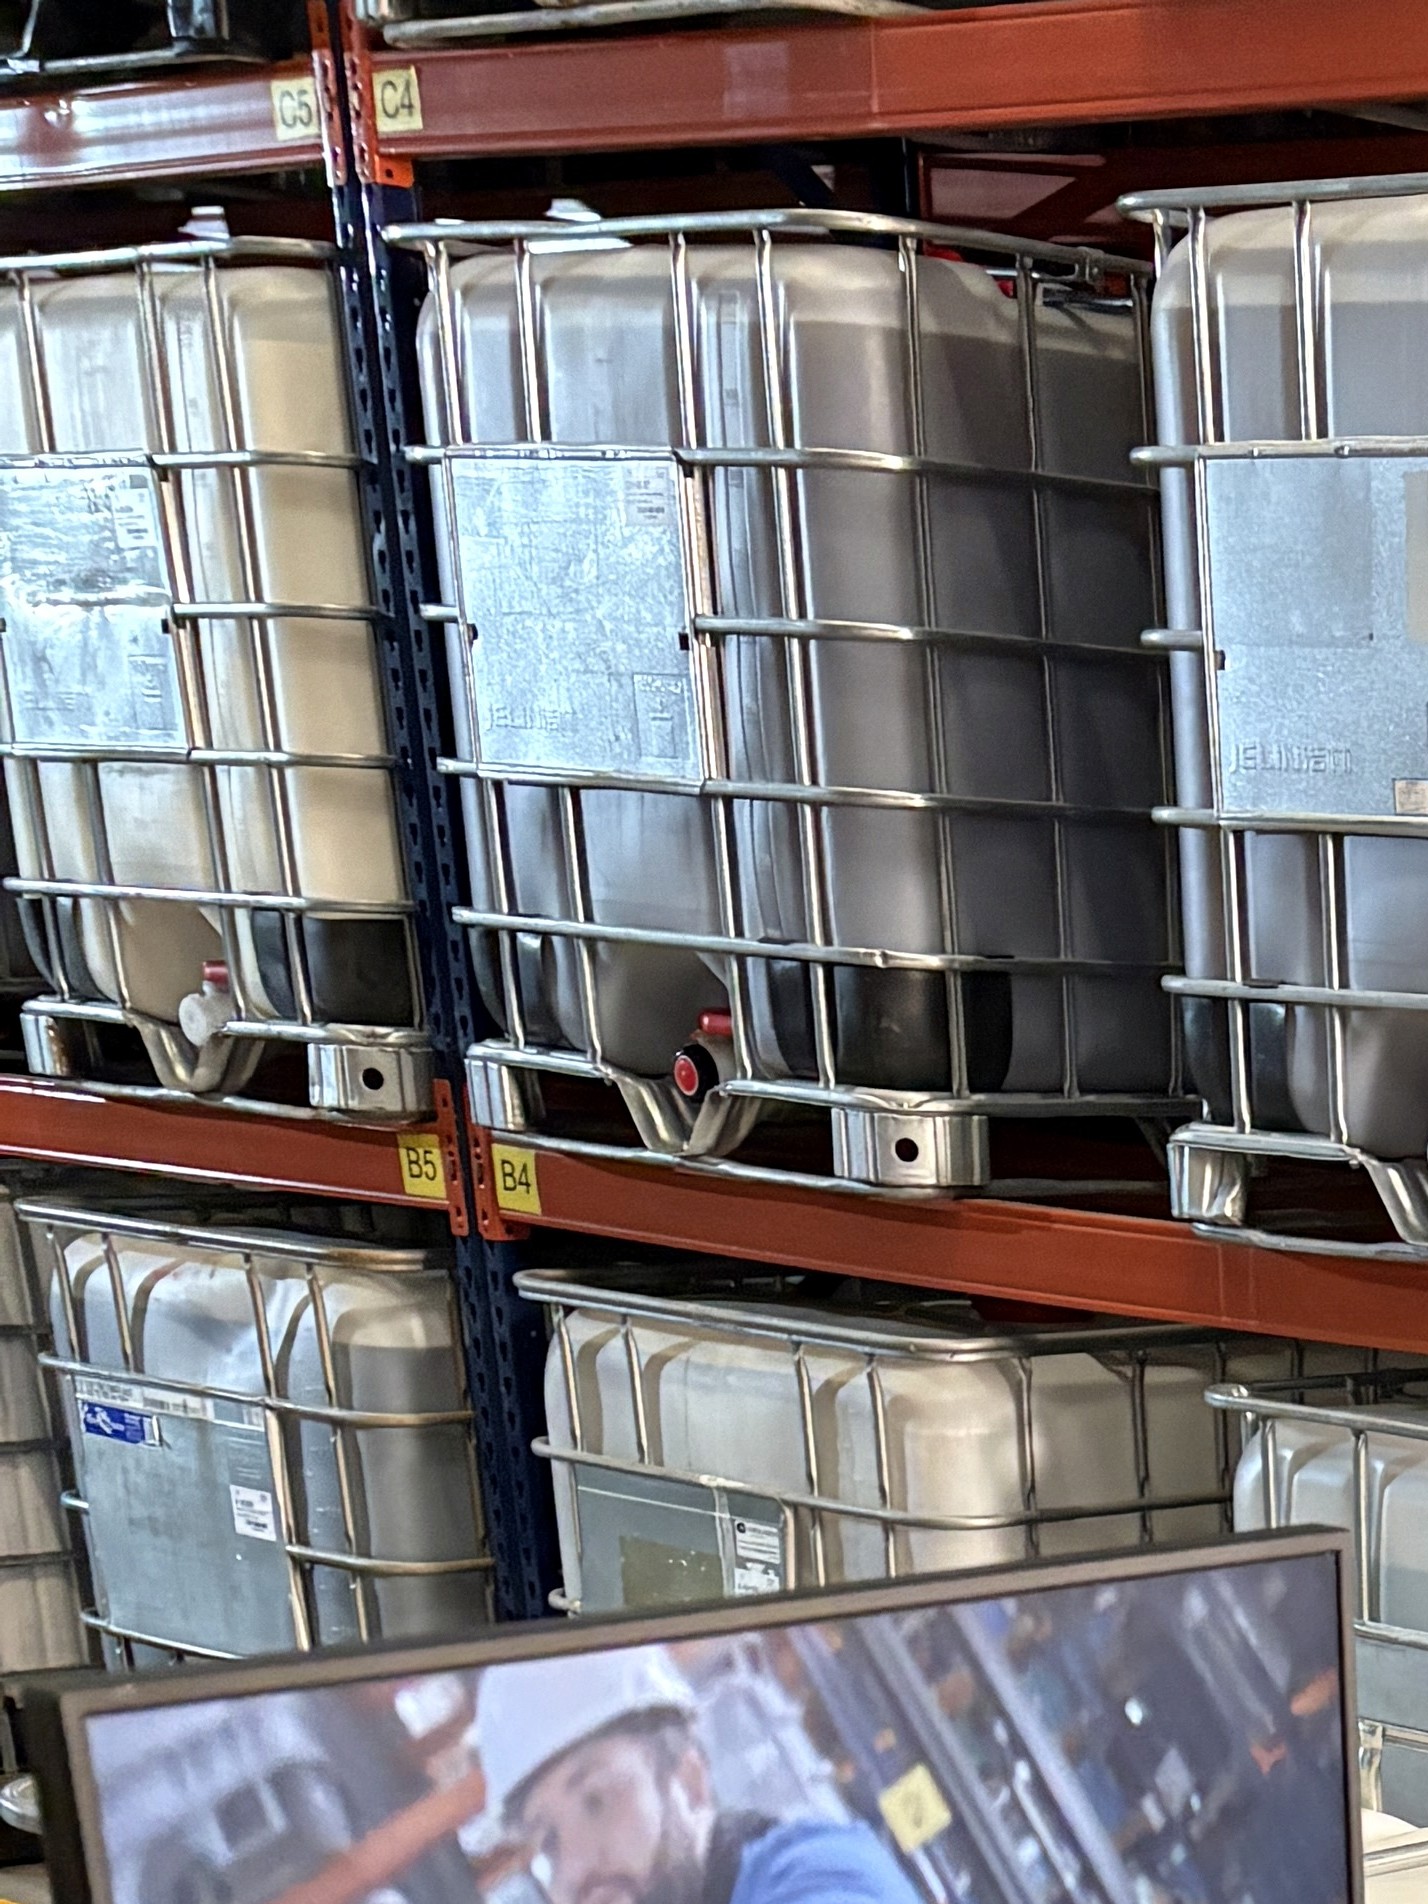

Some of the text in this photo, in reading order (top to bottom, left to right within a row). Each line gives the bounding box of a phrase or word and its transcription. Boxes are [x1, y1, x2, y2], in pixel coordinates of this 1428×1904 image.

[279, 89, 313, 128] C5
[381, 79, 414, 119] C4
[406, 1147, 437, 1181] B5
[501, 1159, 531, 1194] B4
